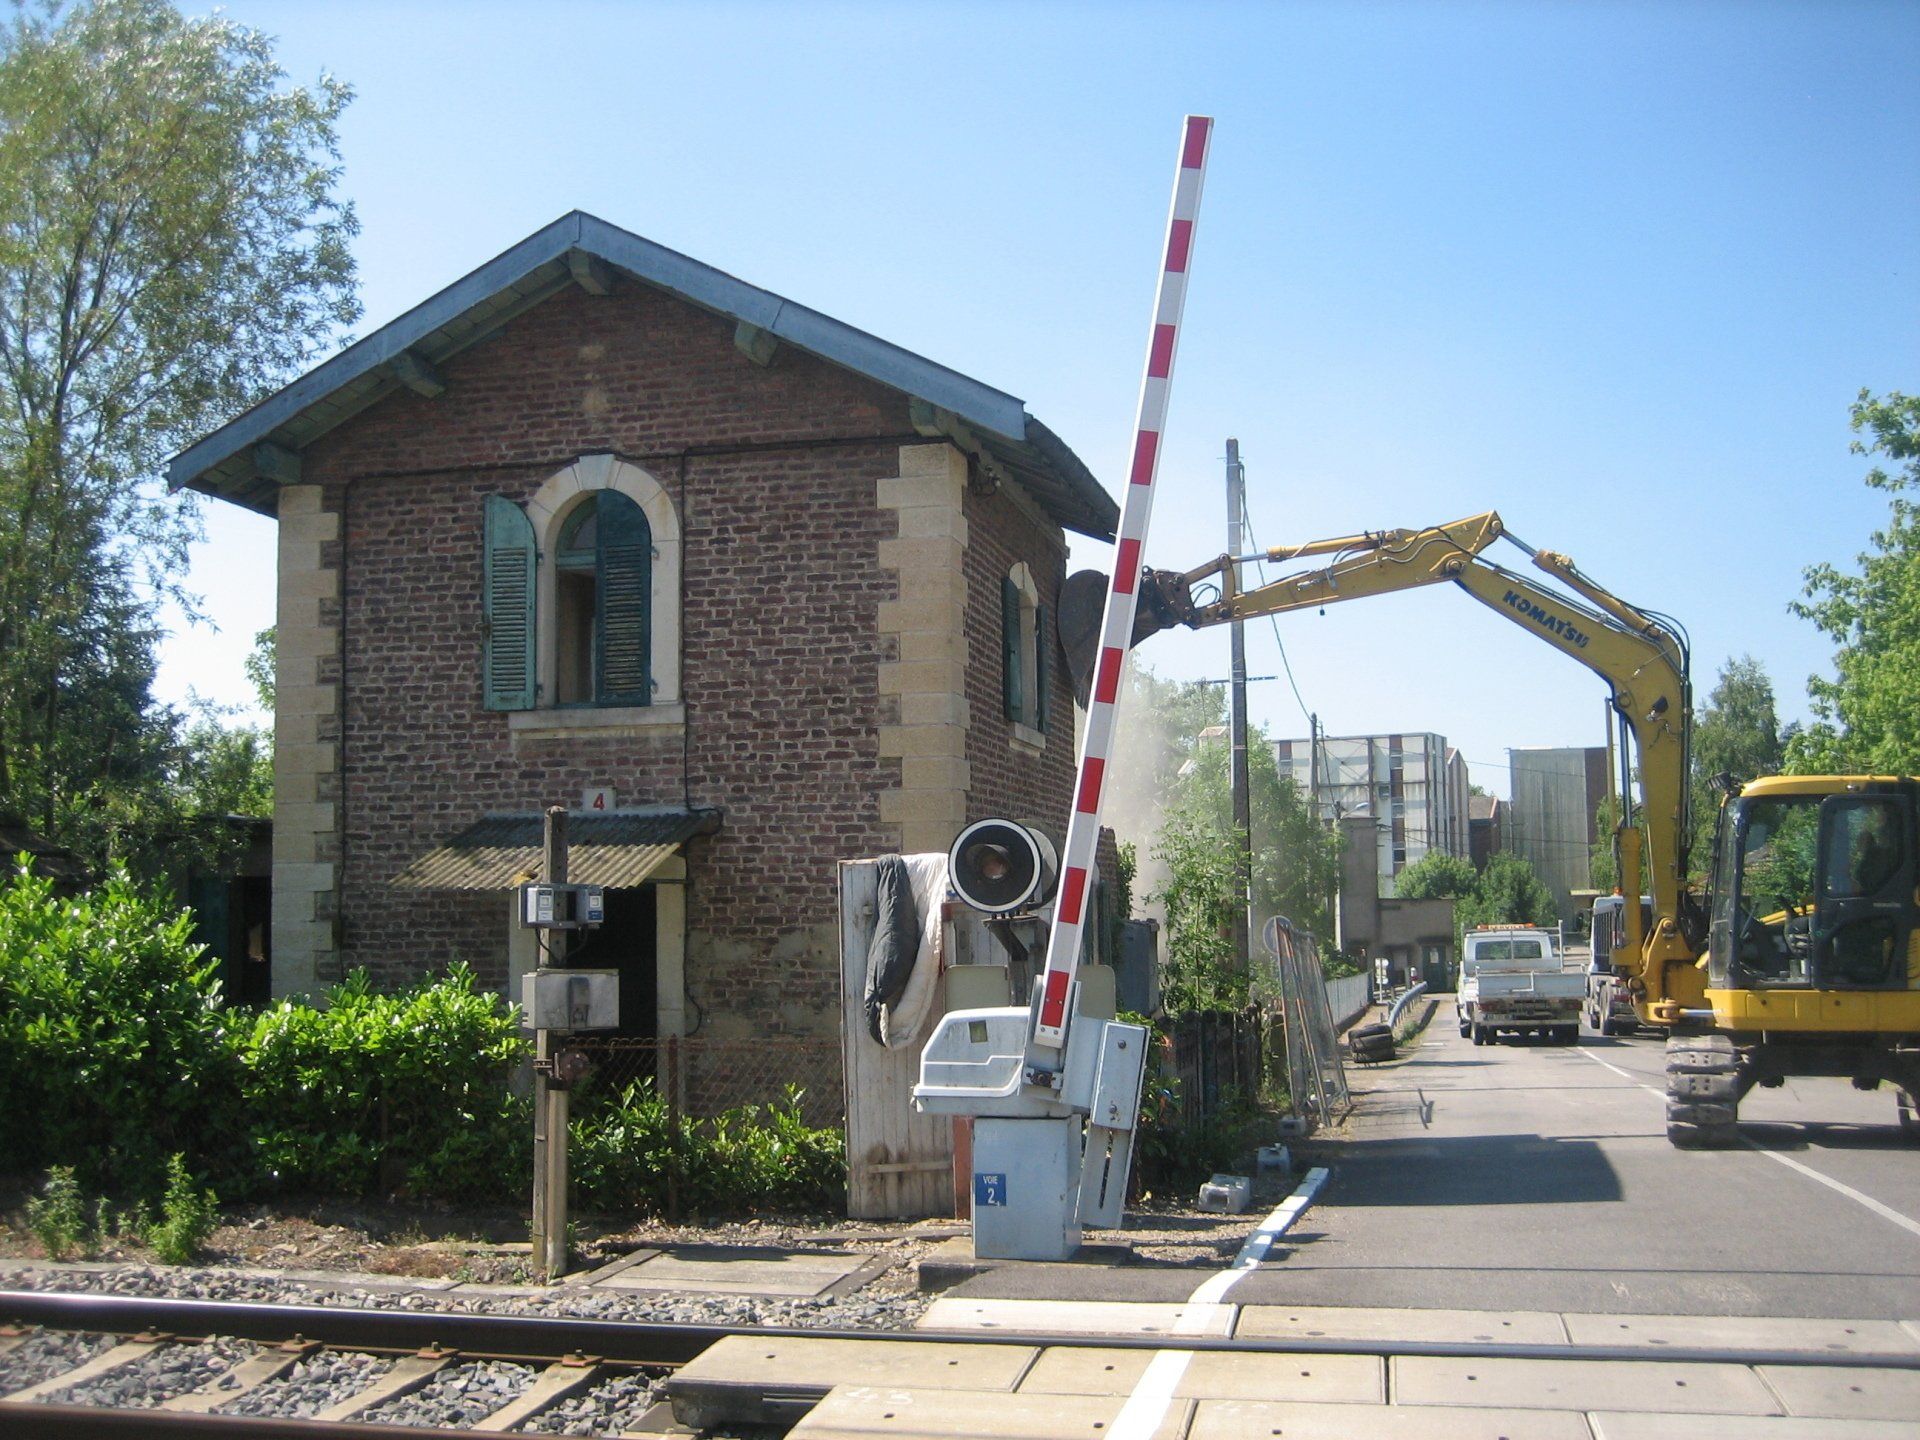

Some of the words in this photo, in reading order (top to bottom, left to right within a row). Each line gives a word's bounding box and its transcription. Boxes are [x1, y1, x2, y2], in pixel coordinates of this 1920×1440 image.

[1503, 590, 1590, 648] KOMATSU
[593, 792, 605, 809] 4
[982, 1175, 998, 1184] VOIE
